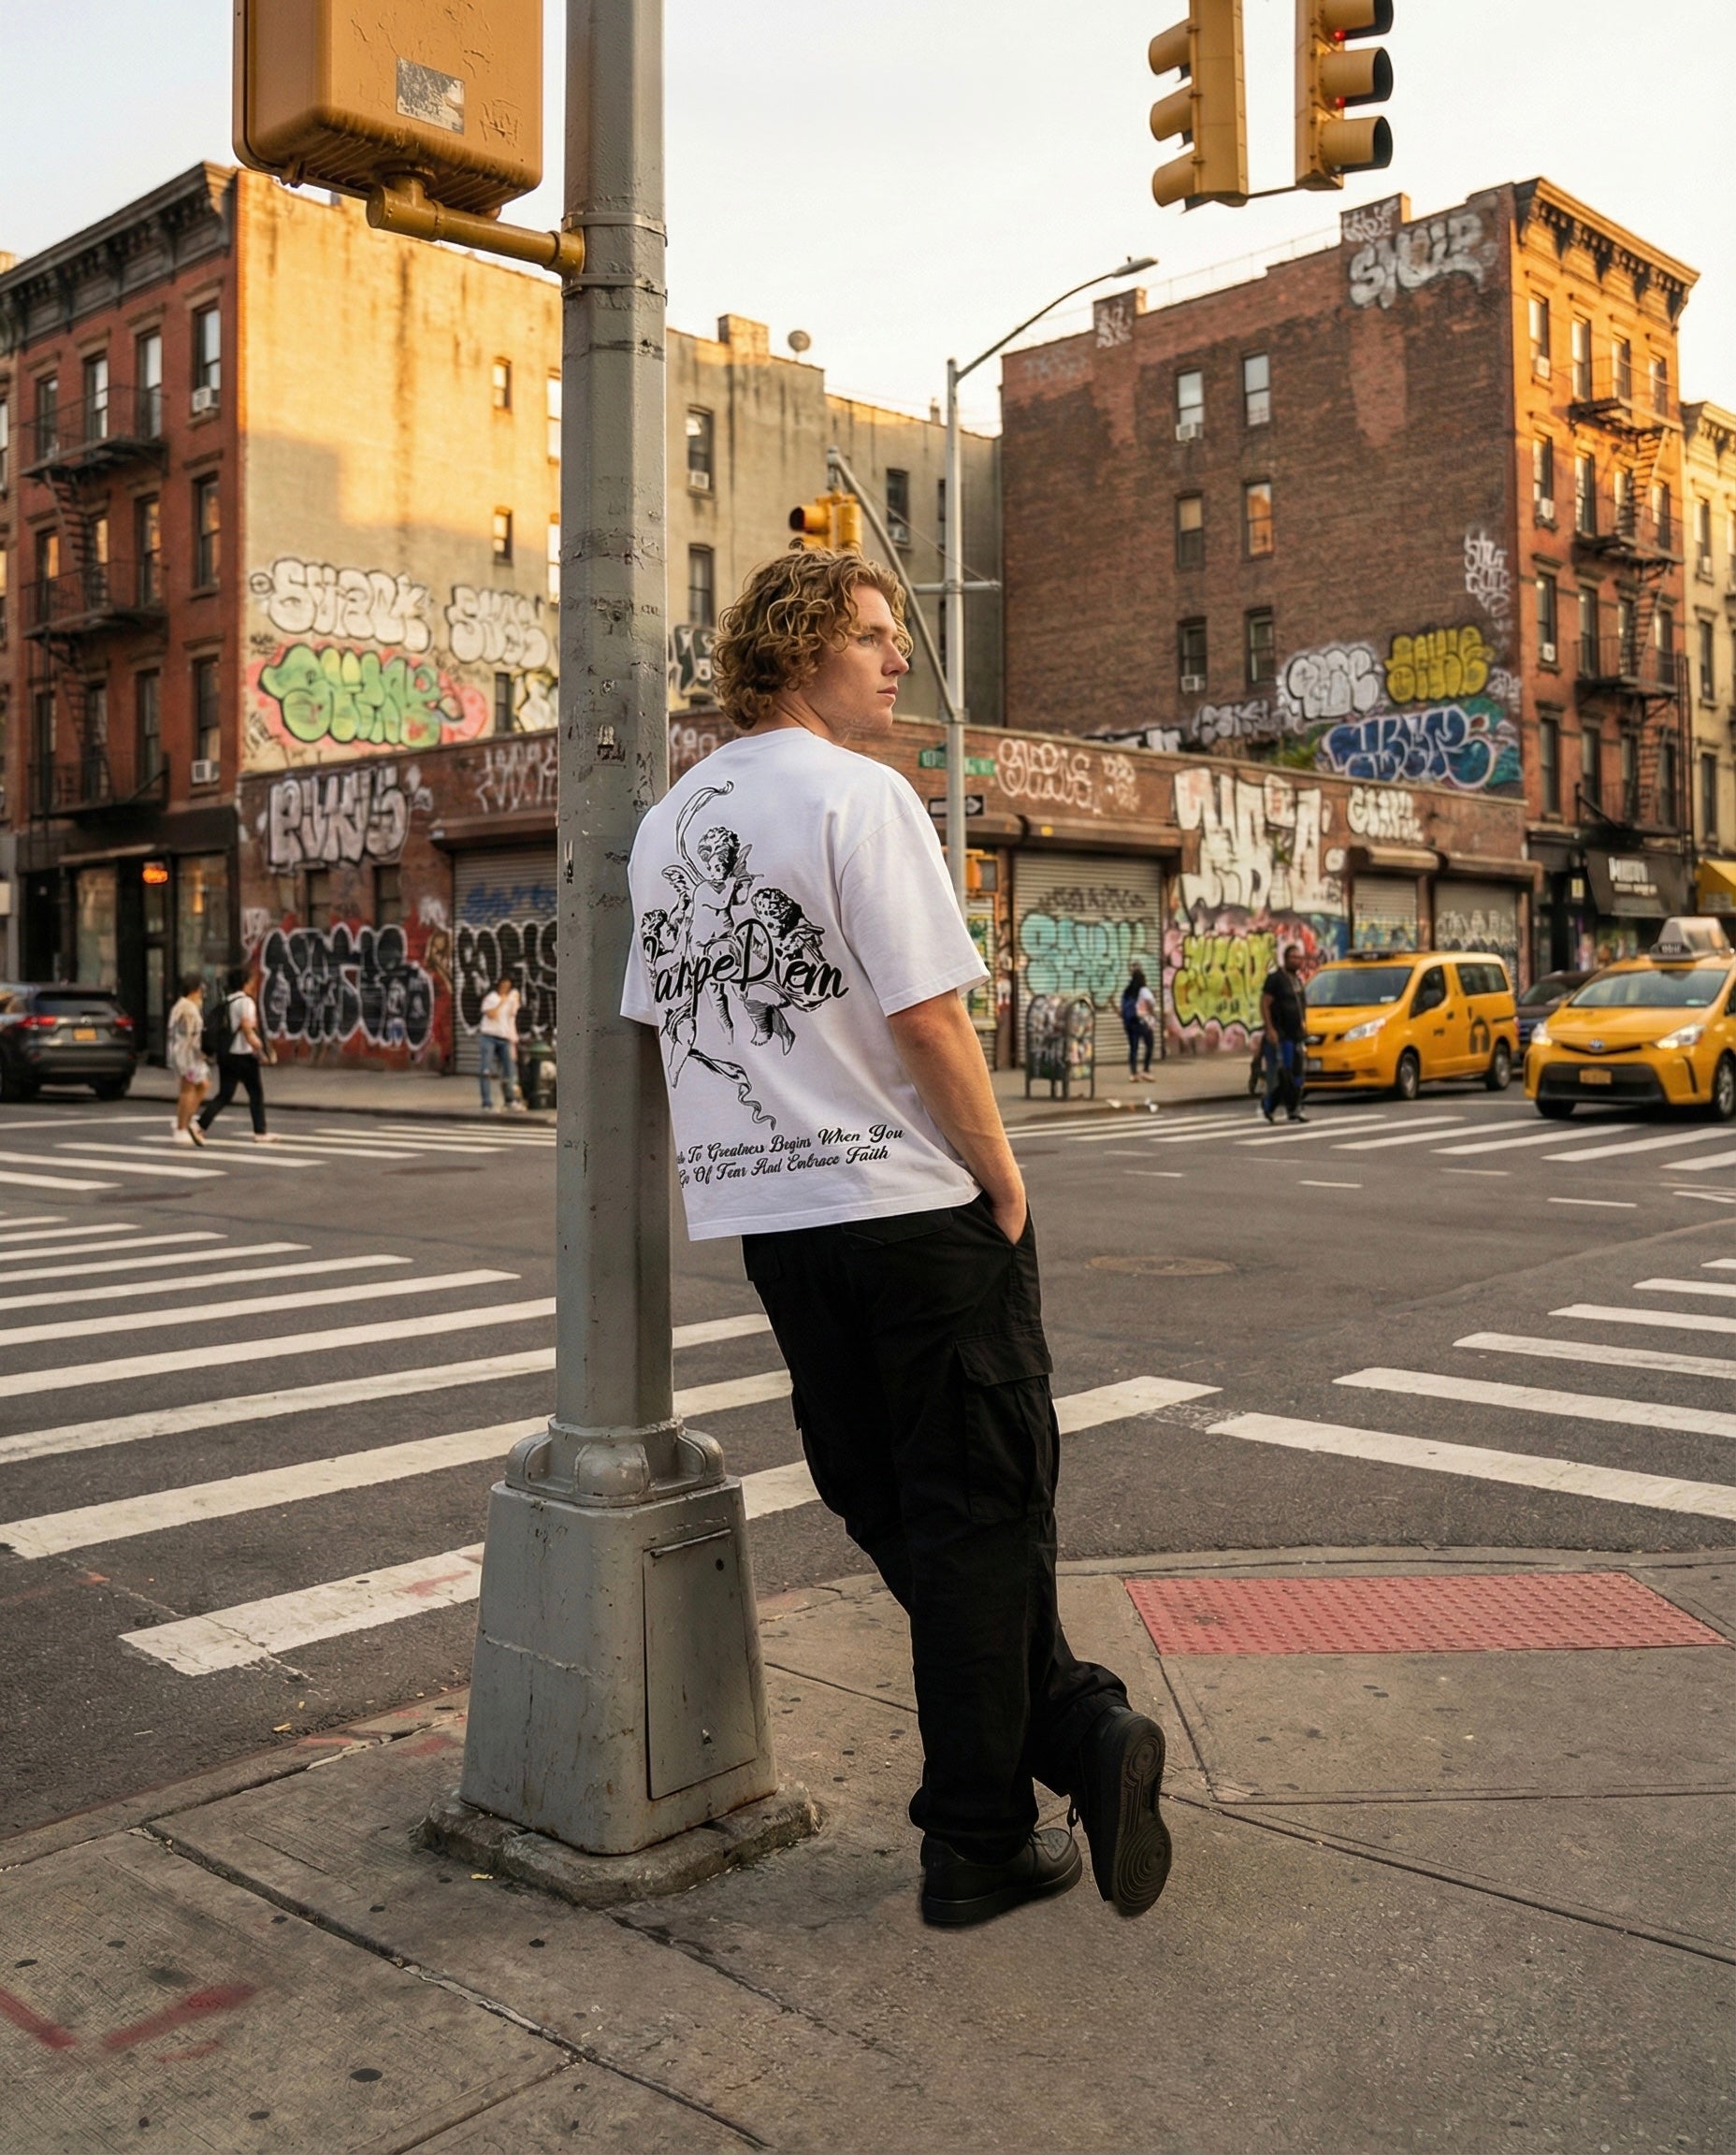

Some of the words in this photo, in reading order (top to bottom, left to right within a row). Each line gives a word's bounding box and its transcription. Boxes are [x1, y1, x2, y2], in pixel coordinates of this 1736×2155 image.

[688, 1145, 702, 1164] To
[707, 1143, 764, 1162] Greatness
[769, 1135, 811, 1154] Begins
[817, 1128, 861, 1145] When
[869, 1124, 904, 1143] You
[693, 1165, 713, 1185] Of
[751, 1157, 783, 1176] And
[846, 1145, 889, 1164] Faith
